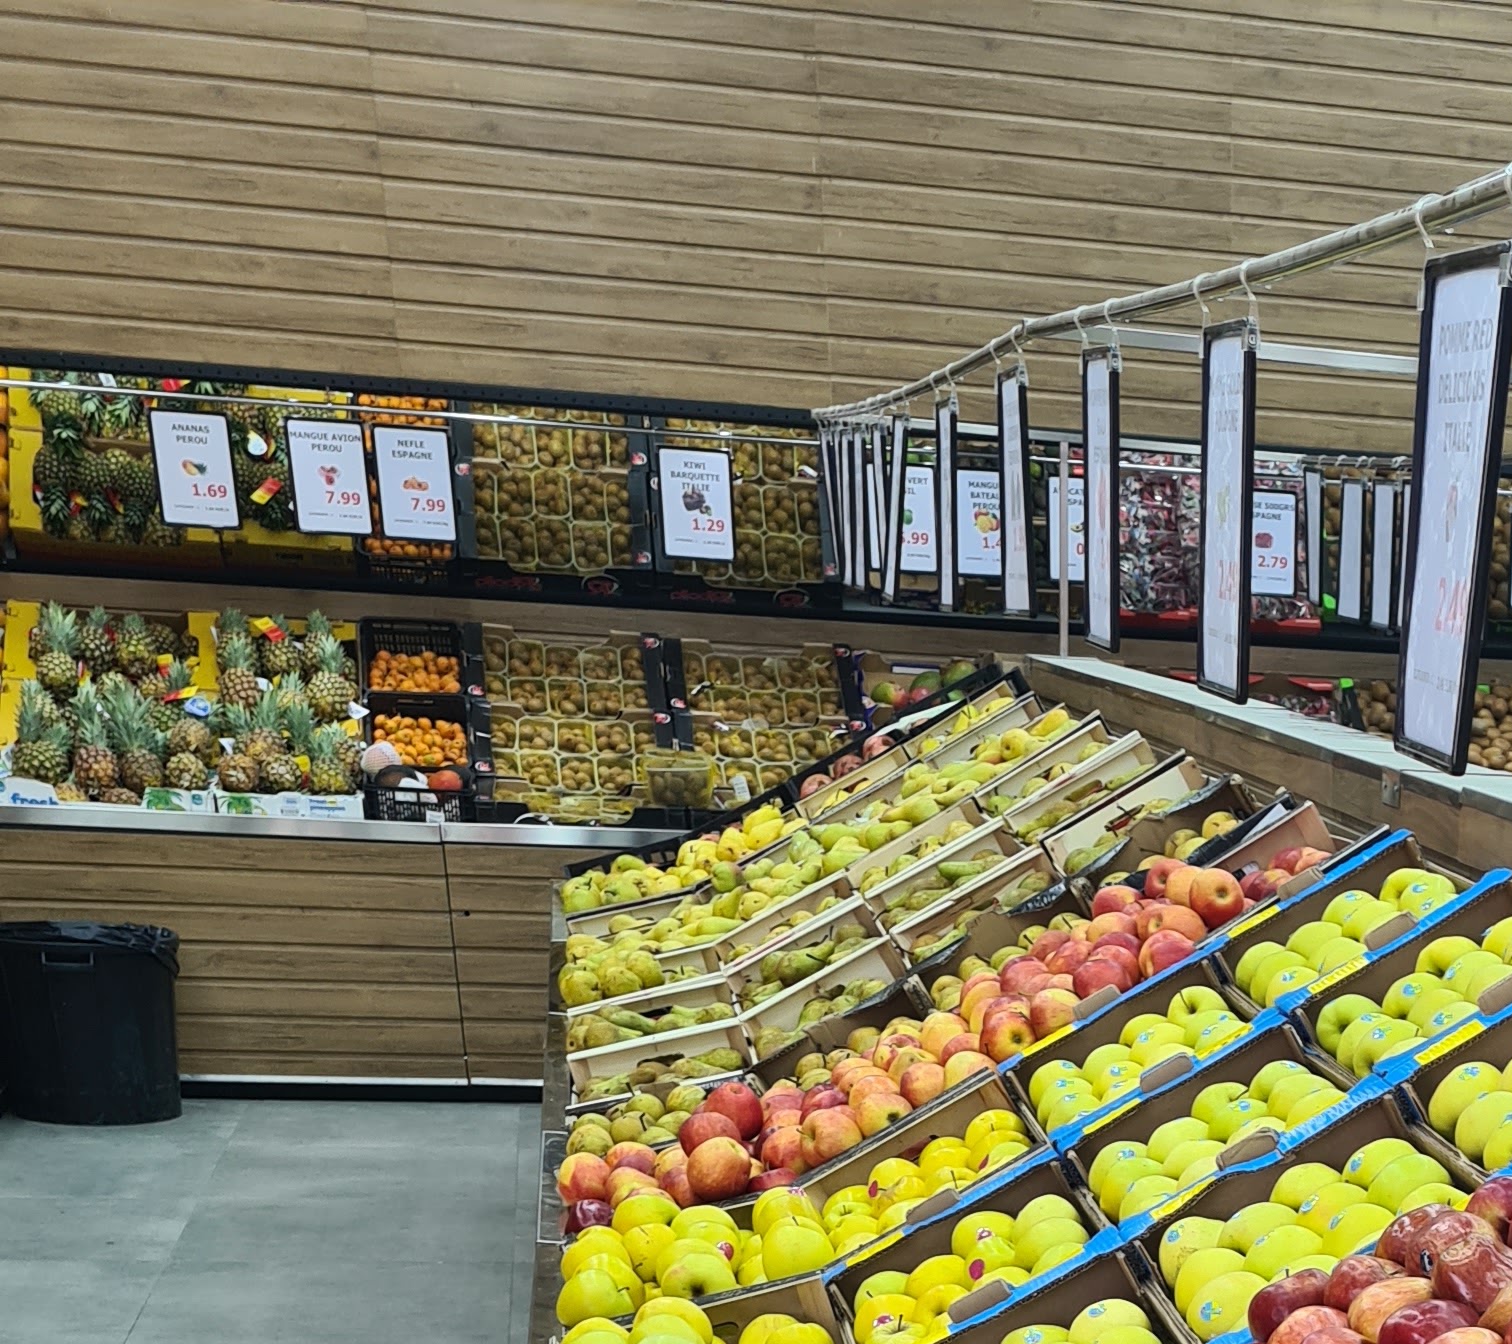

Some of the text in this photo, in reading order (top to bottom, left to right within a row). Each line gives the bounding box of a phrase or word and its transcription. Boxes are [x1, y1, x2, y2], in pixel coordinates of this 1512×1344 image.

[1472, 318, 1493, 352] RED
[171, 423, 210, 434] ANANAS
[176, 435, 208, 445] PEROU
[289, 431, 361, 442] MANGUE AVION
[311, 443, 342, 452] PEROU
[397, 439, 425, 448] NEFLE
[392, 450, 433, 460] ESPAGNE
[683, 461, 706, 470] KIWI
[670, 471, 720, 482] BARQUETTE
[192, 483, 227, 498] 1.69
[681, 483, 710, 492] ITALIE
[326, 491, 361, 505] 7.99
[411, 497, 445, 512] 7.99
[692, 518, 725, 532] 1.29
[1257, 555, 1288, 569] 2.79
